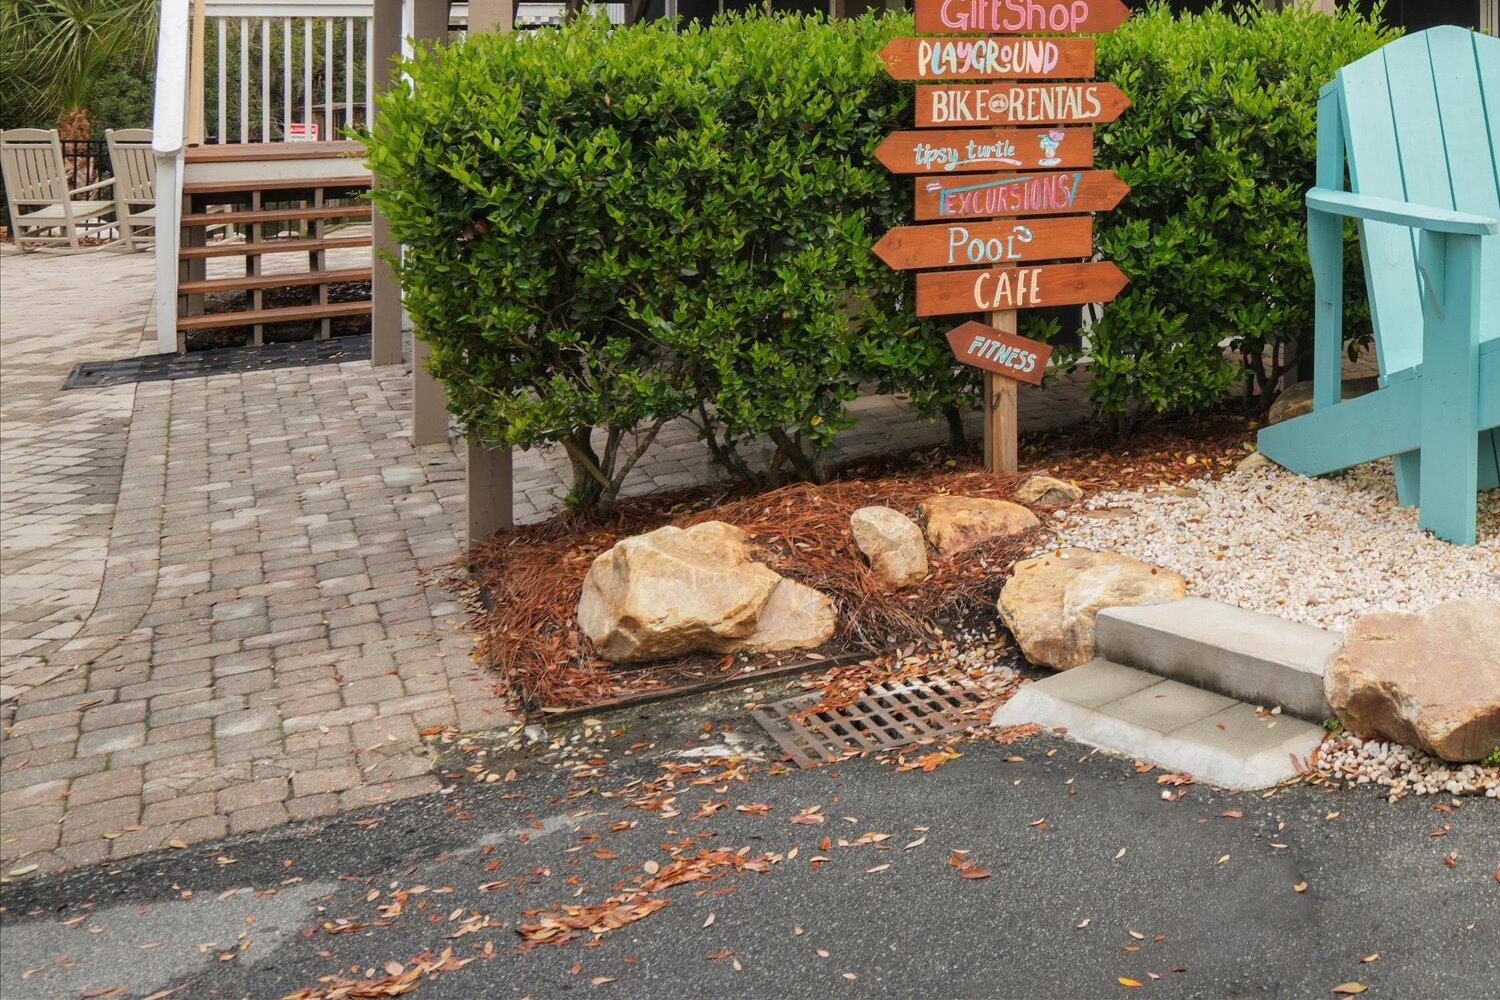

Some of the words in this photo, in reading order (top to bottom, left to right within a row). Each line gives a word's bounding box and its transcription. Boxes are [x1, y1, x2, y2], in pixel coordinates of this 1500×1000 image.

[918, 39, 1059, 76] PLAYGROUND
[931, 89, 990, 122] BIKE
[1007, 86, 1101, 122] RENTALS
[913, 143, 959, 171] tipsy
[966, 139, 1016, 160] turtle
[944, 174, 1073, 215] EXCURSIONS
[974, 269, 1042, 309] CAFE
[968, 336, 1037, 373] FITNESS
